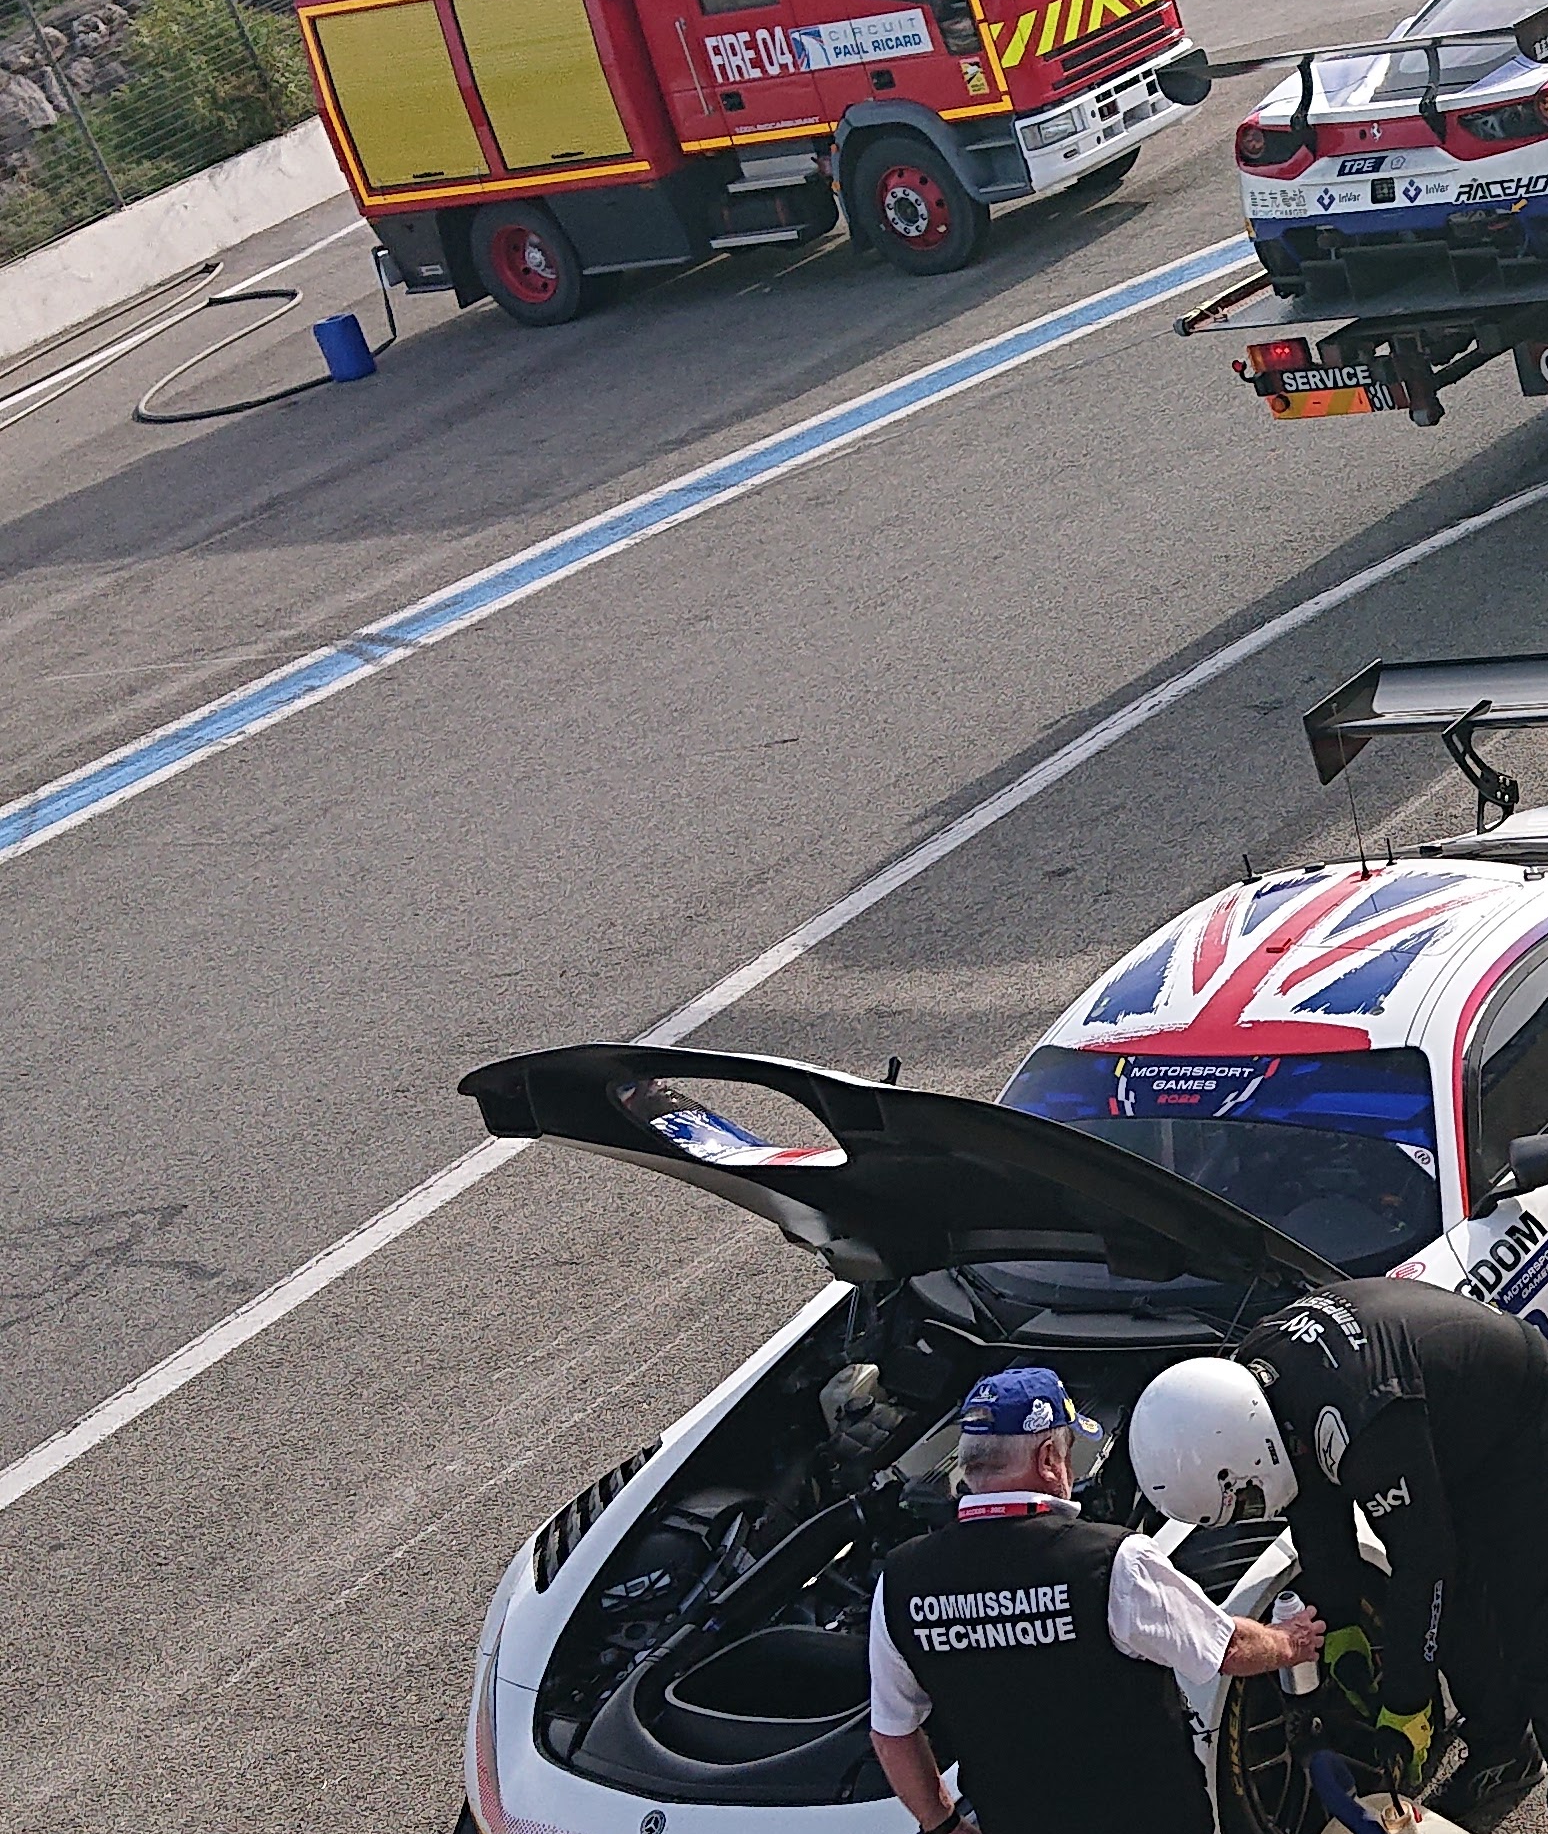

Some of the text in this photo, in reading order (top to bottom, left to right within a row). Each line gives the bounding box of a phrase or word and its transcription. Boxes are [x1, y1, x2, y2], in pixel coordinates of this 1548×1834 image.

[828, 17, 917, 42] CIRCUIT
[704, 25, 796, 84] FIRE 04
[833, 33, 922, 59] PAUL RICARD
[1343, 158, 1376, 173] TPE
[1425, 182, 1450, 195] InVar
[1281, 365, 1373, 392] SERVICE
[1130, 1065, 1255, 1079] MOTORSPORT
[1152, 1079, 1218, 1091] GAMES
[1366, 1476, 1412, 1518] sky
[909, 1583, 1071, 1622] COMMISSAIRE
[913, 1615, 1077, 1652] TECHNIQUE
